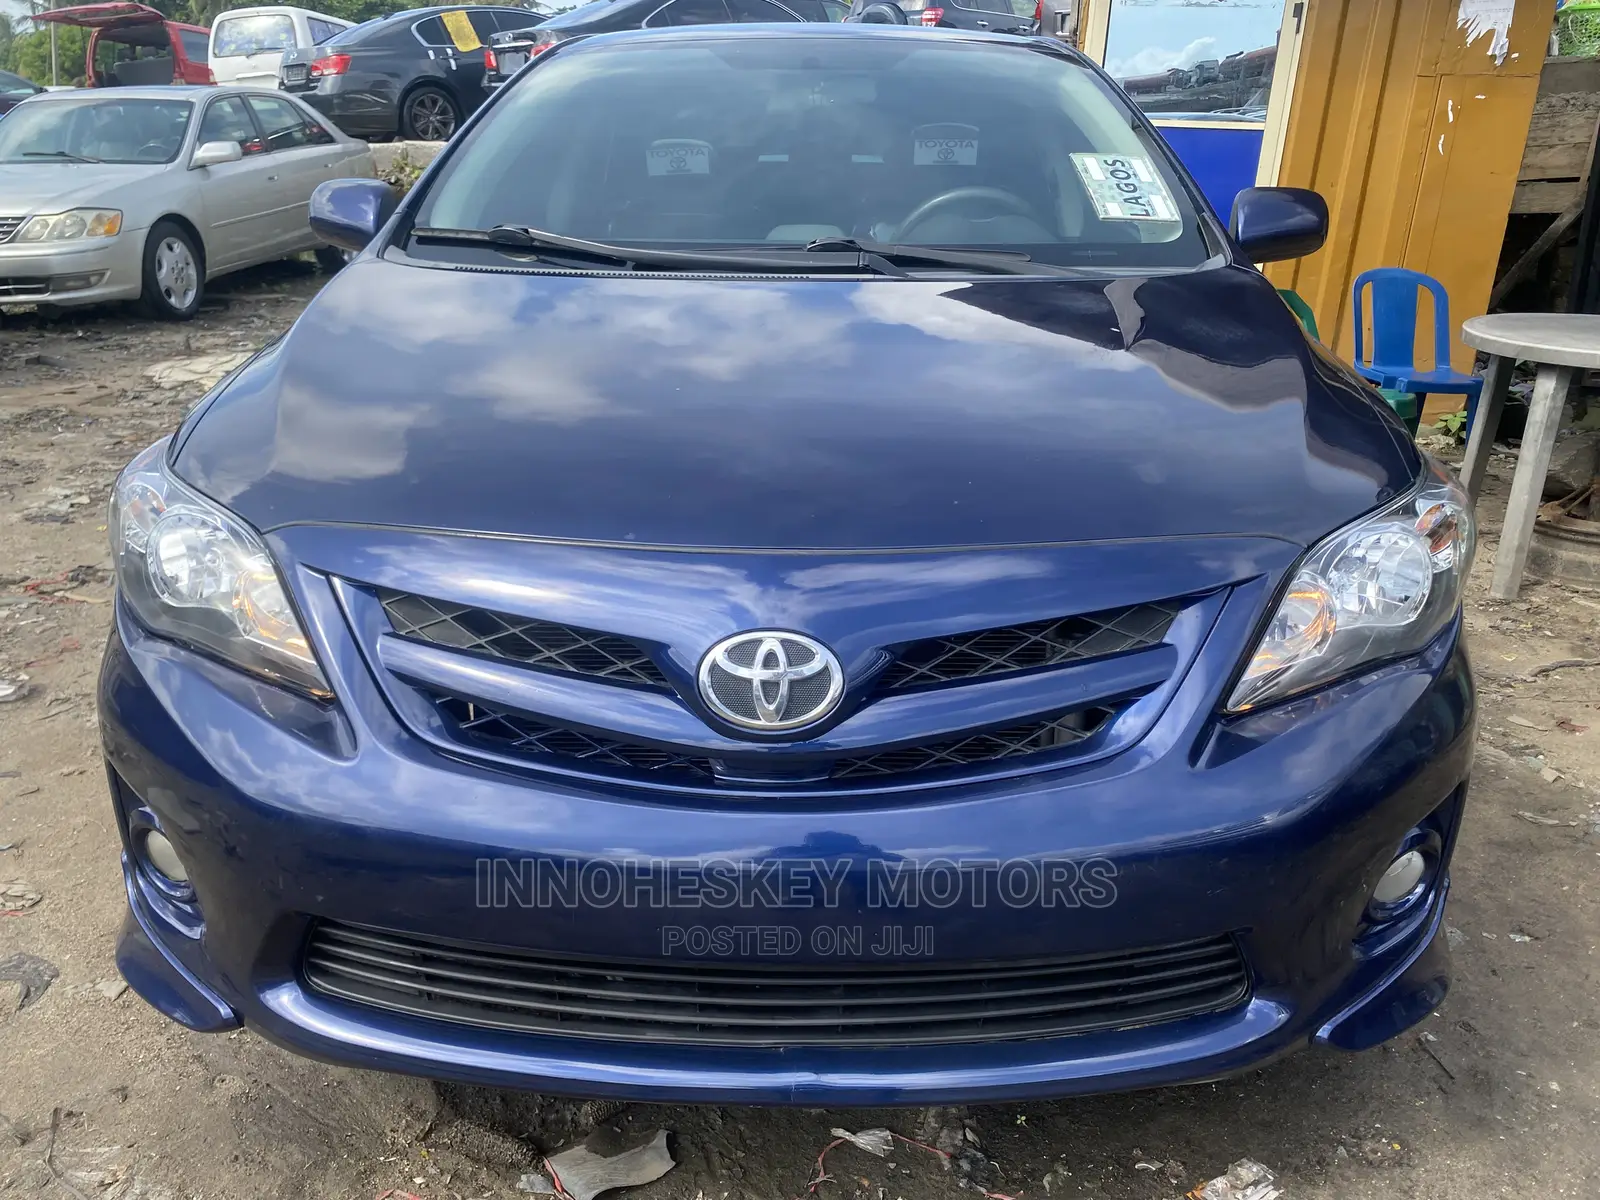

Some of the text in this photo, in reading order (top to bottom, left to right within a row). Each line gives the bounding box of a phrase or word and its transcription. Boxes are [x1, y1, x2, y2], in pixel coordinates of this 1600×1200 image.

[916, 140, 975, 149] TOYOTA
[648, 147, 706, 158] TOYOTA
[1103, 159, 1151, 217] LAGOS
